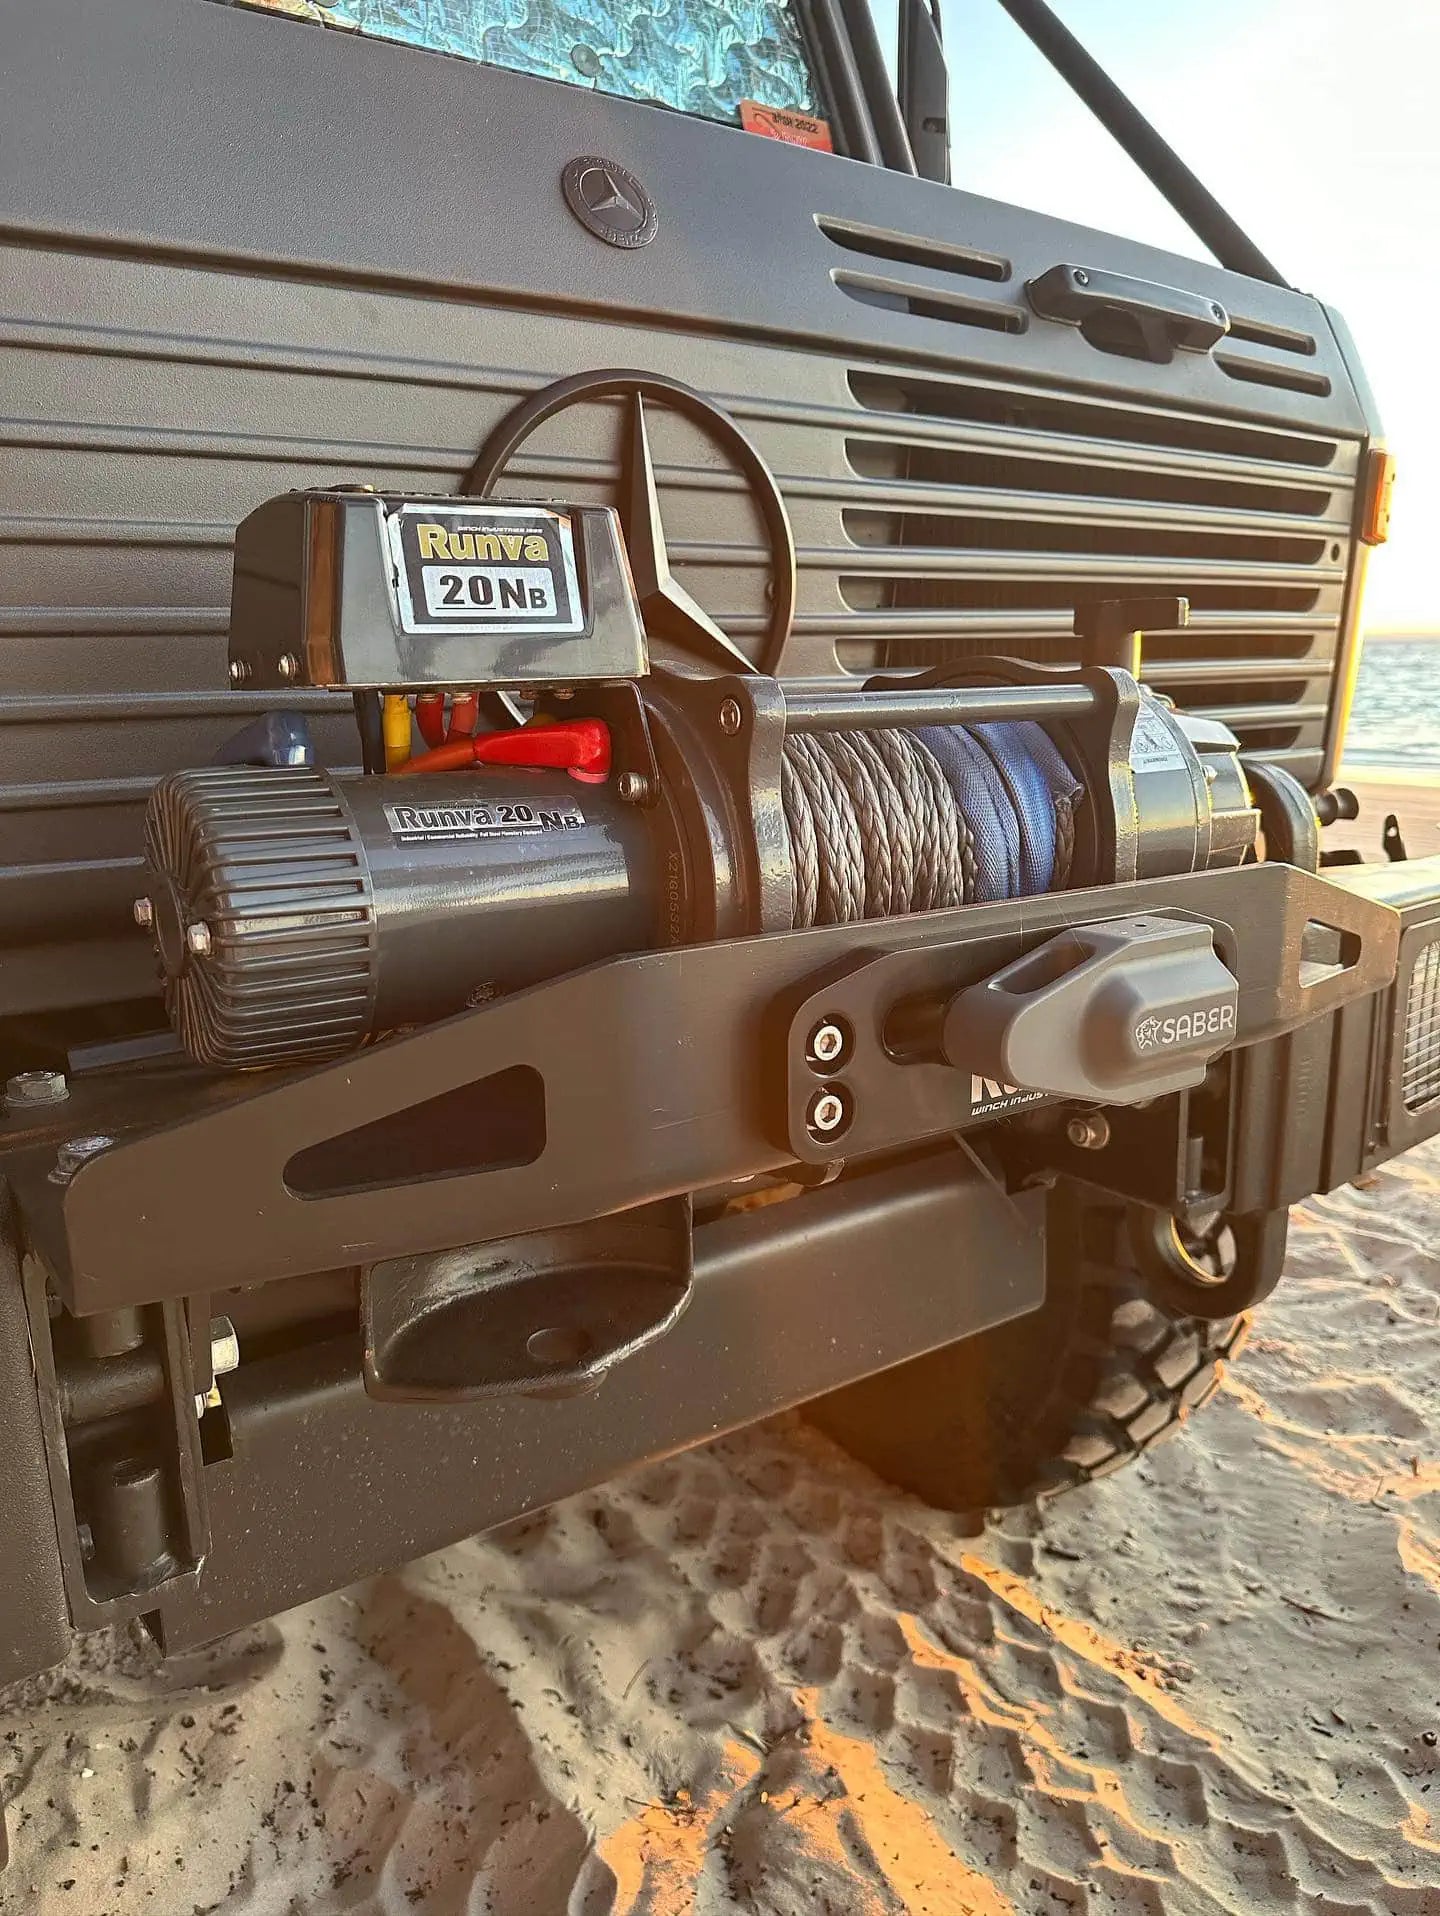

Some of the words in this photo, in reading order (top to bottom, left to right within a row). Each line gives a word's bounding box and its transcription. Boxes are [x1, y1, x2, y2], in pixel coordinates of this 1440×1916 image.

[416, 523, 550, 561] Runva
[392, 806, 492, 829] Runva
[1161, 1004, 1234, 1043] SABER
